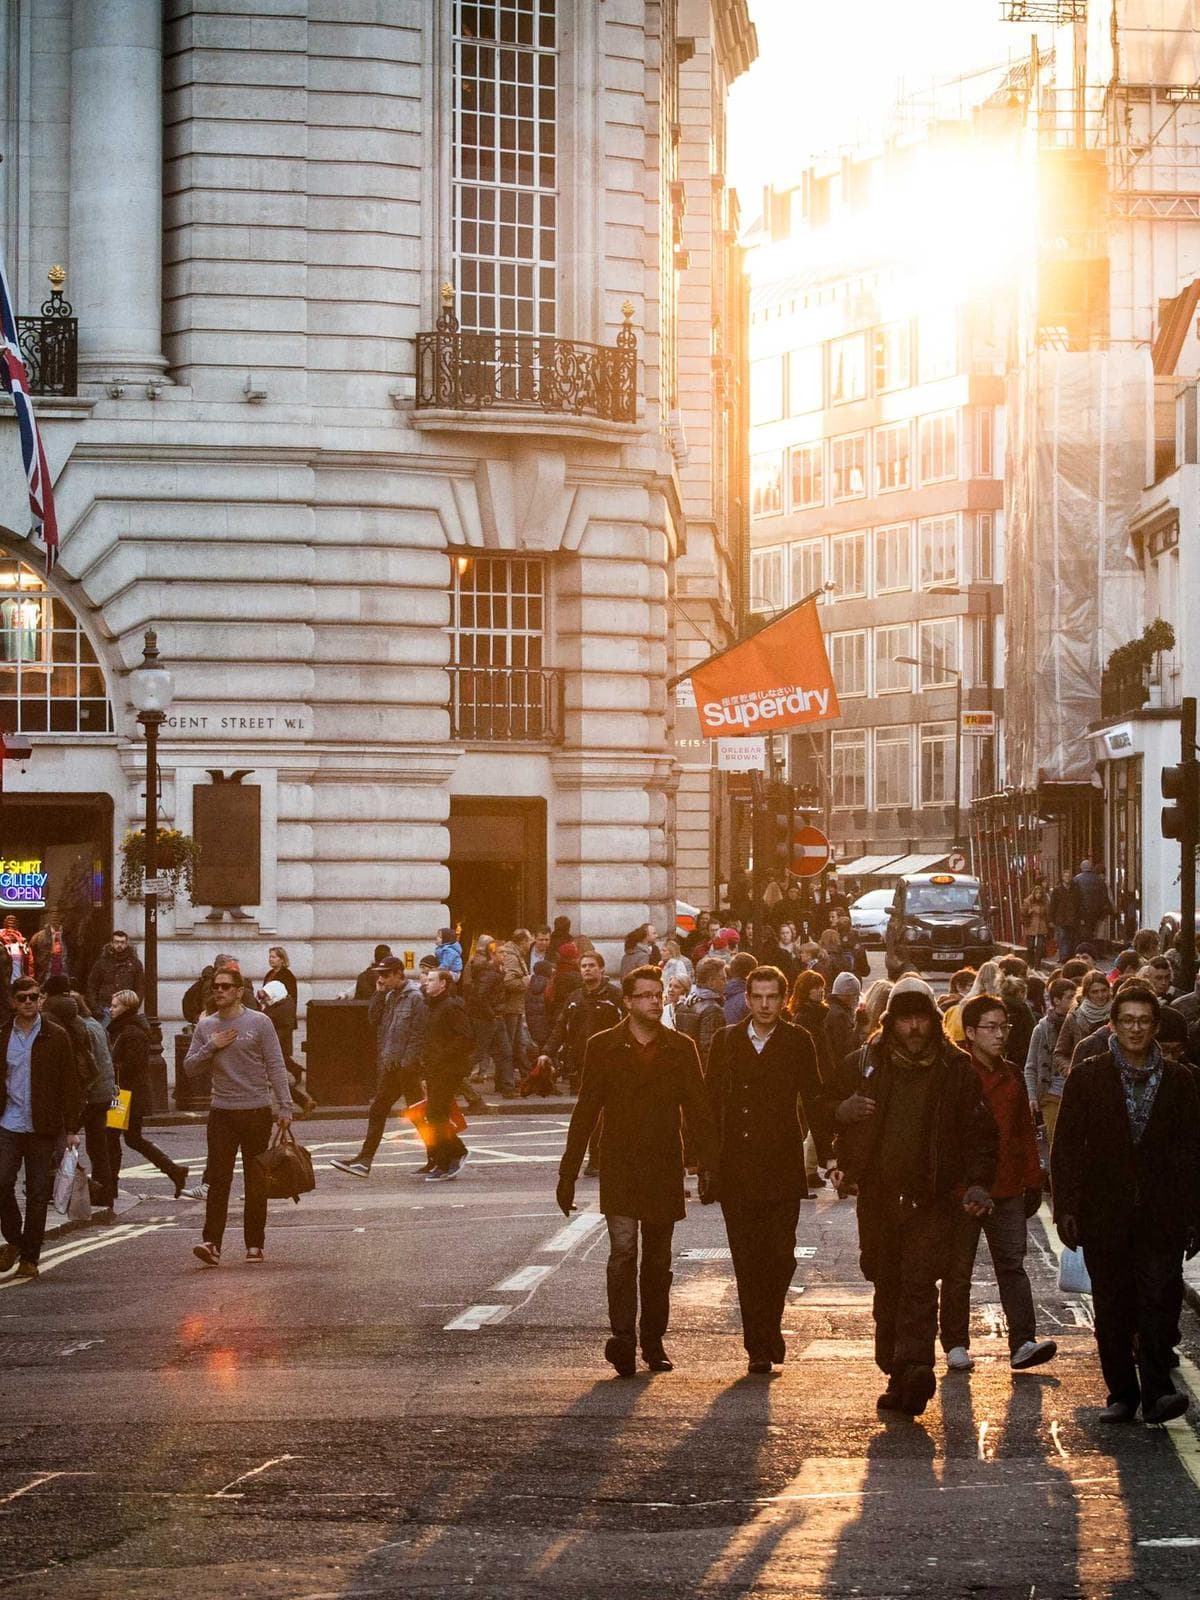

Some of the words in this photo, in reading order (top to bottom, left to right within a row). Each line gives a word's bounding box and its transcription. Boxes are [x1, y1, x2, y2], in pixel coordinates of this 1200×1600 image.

[703, 687, 829, 727] Superdry
[160, 716, 208, 729] GENT
[221, 717, 275, 729] STREET
[0, 873, 48, 887] GALLERY
